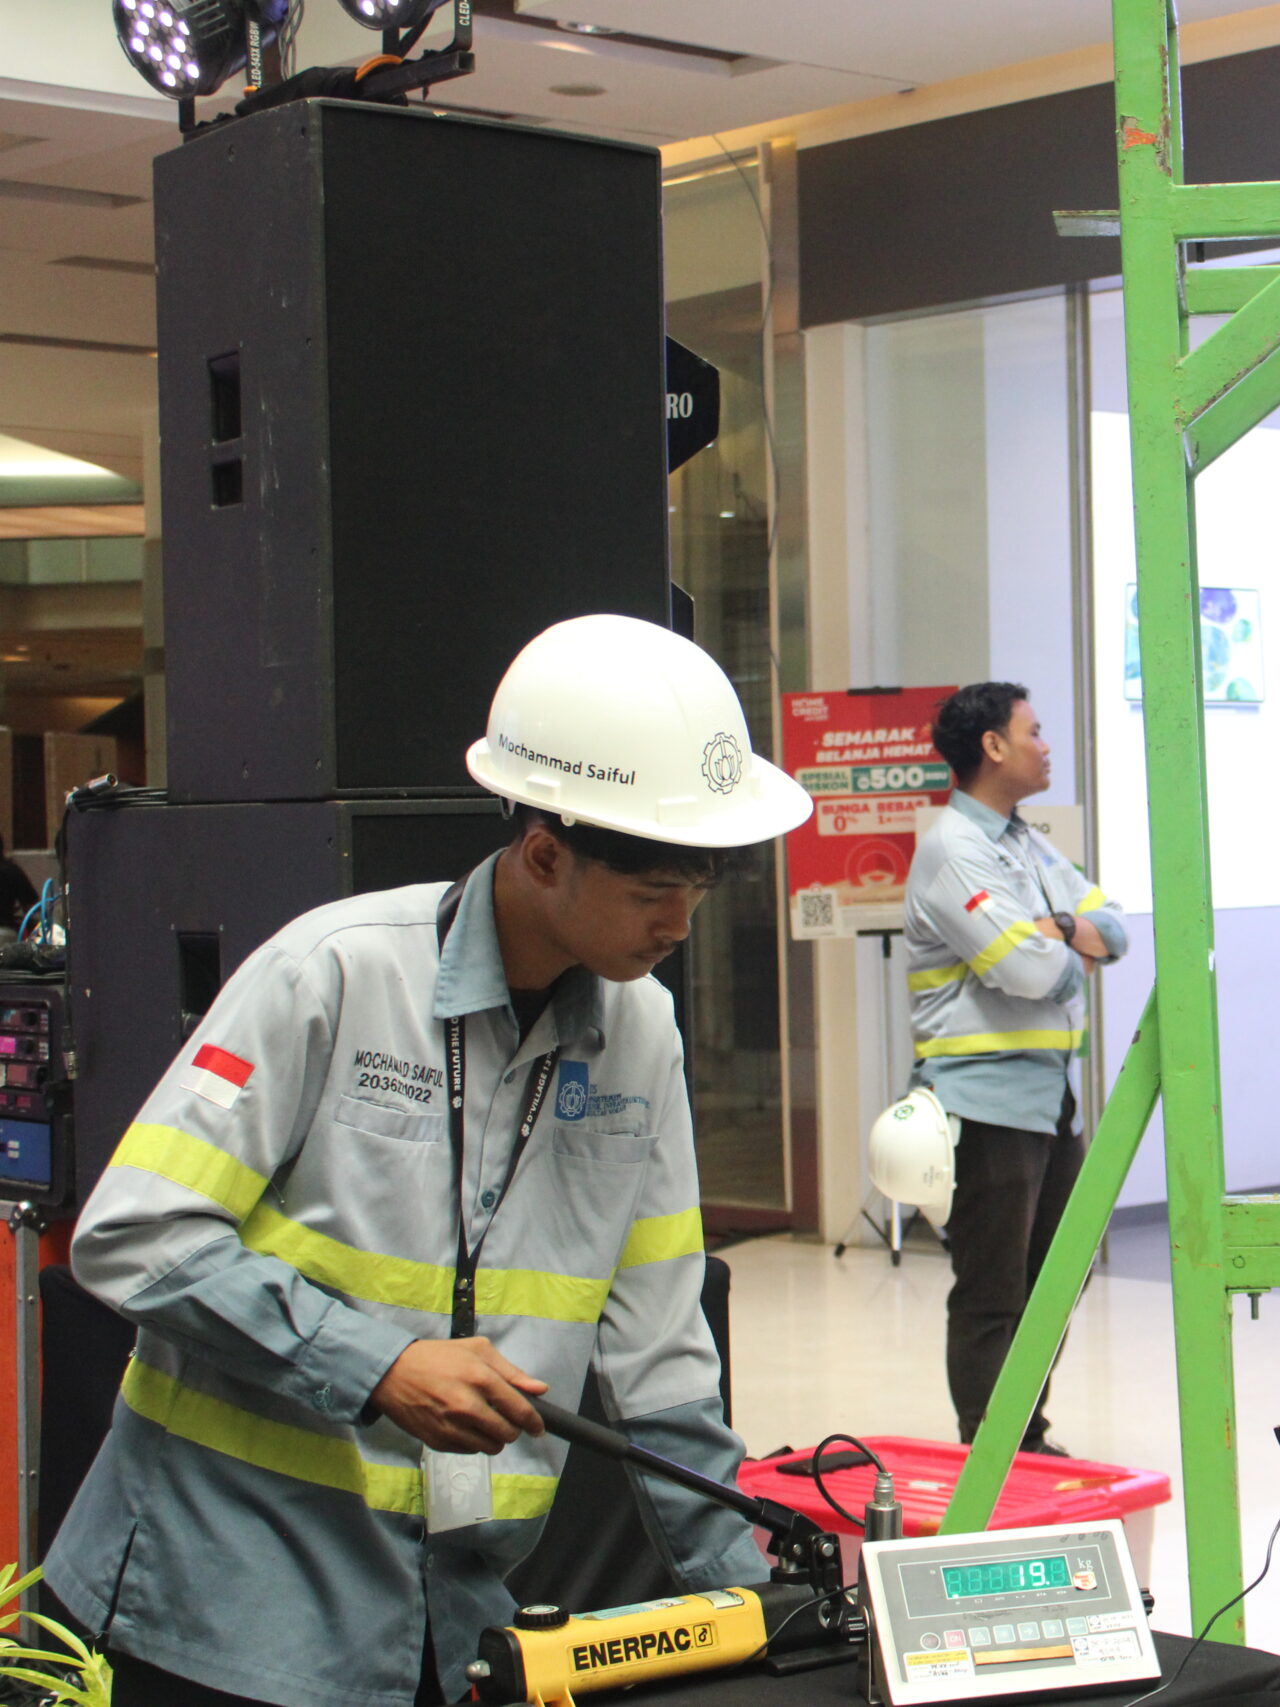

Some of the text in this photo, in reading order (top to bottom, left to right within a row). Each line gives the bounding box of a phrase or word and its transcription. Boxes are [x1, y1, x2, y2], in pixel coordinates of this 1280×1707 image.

[791, 706, 828, 717] CREDIT
[822, 728, 916, 747] SEMARAK
[499, 733, 636, 786] Mochammad Saiful
[815, 746, 880, 763] BELANJA
[821, 803, 871, 815] BUNGA
[411, 1064, 444, 1088] SAIFUL
[452, 1049, 462, 1092] FUTURE
[572, 1627, 692, 1672] ENERPAC
